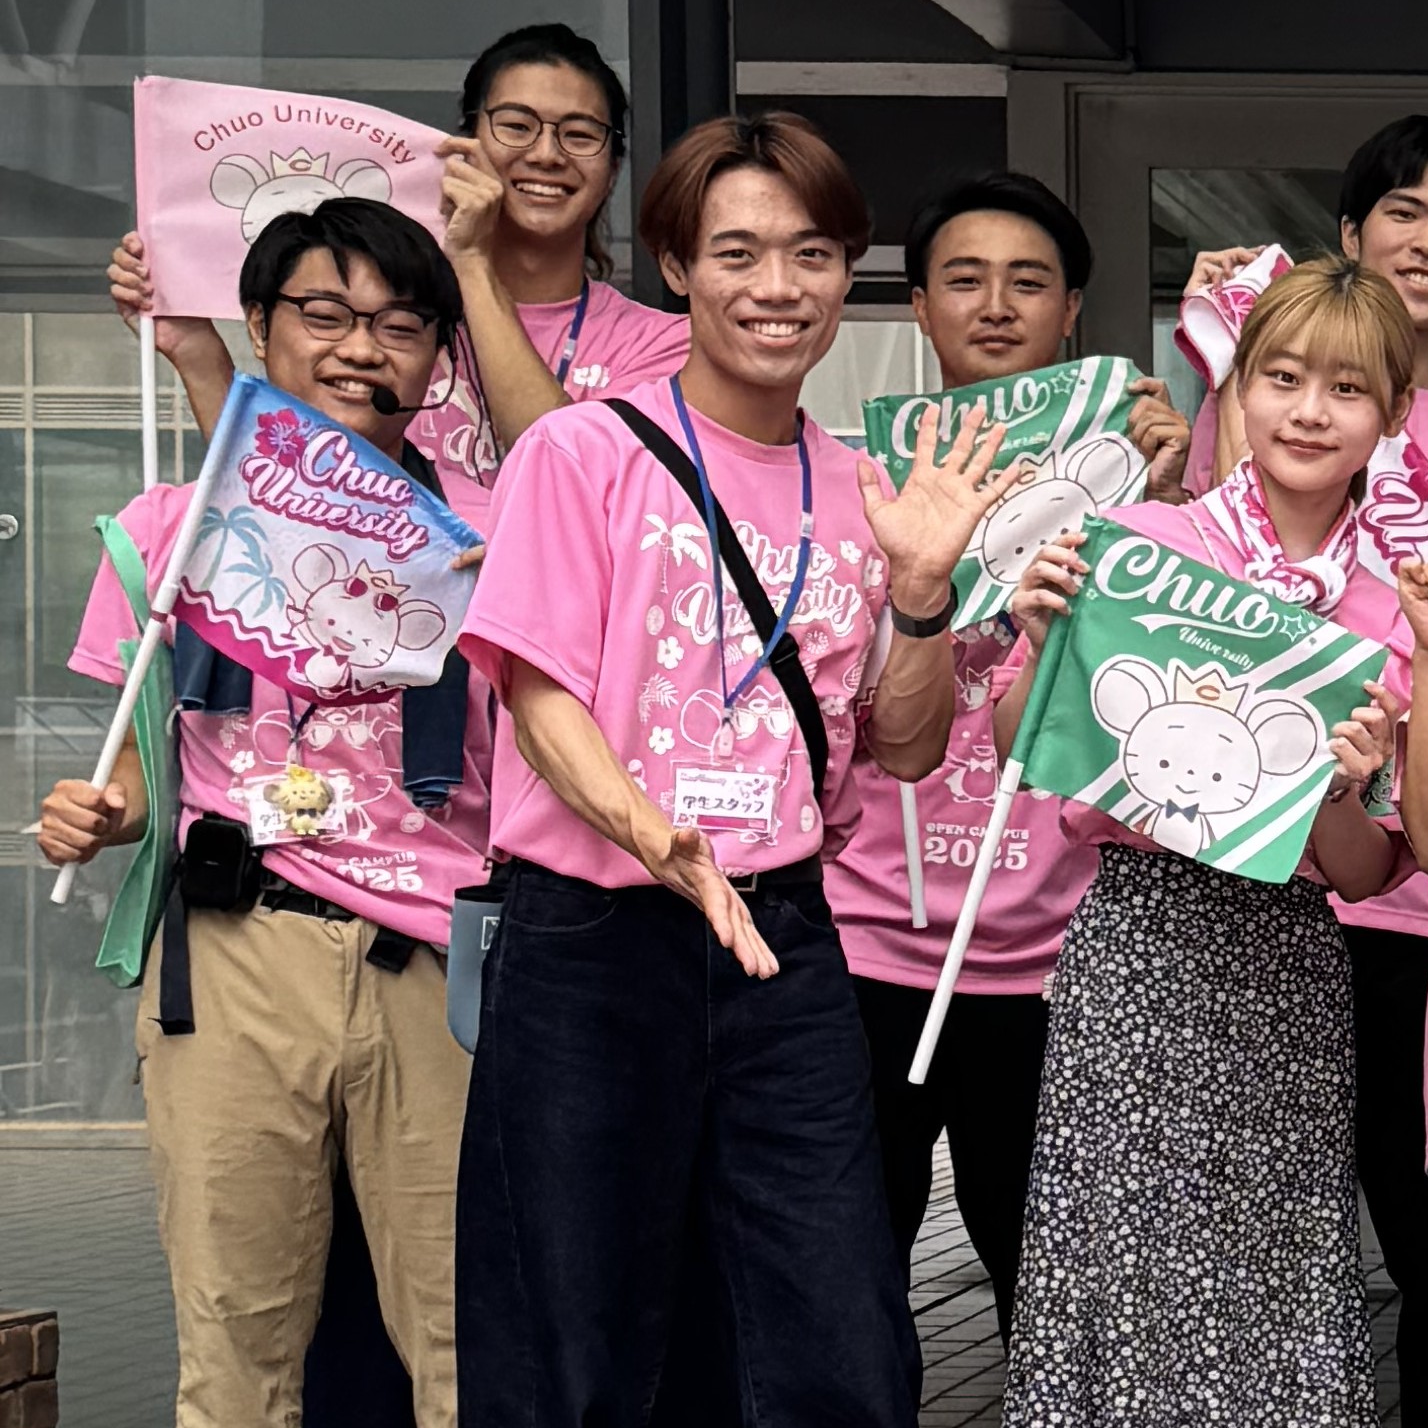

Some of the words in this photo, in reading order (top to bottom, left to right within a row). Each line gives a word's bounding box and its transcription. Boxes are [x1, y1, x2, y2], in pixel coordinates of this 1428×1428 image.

[193, 111, 263, 152] Chuo
[273, 104, 417, 165] University
[300, 427, 415, 507] Chuo
[240, 454, 430, 563] University
[1095, 535, 1279, 634] Chuo
[923, 836, 1029, 871] 205
